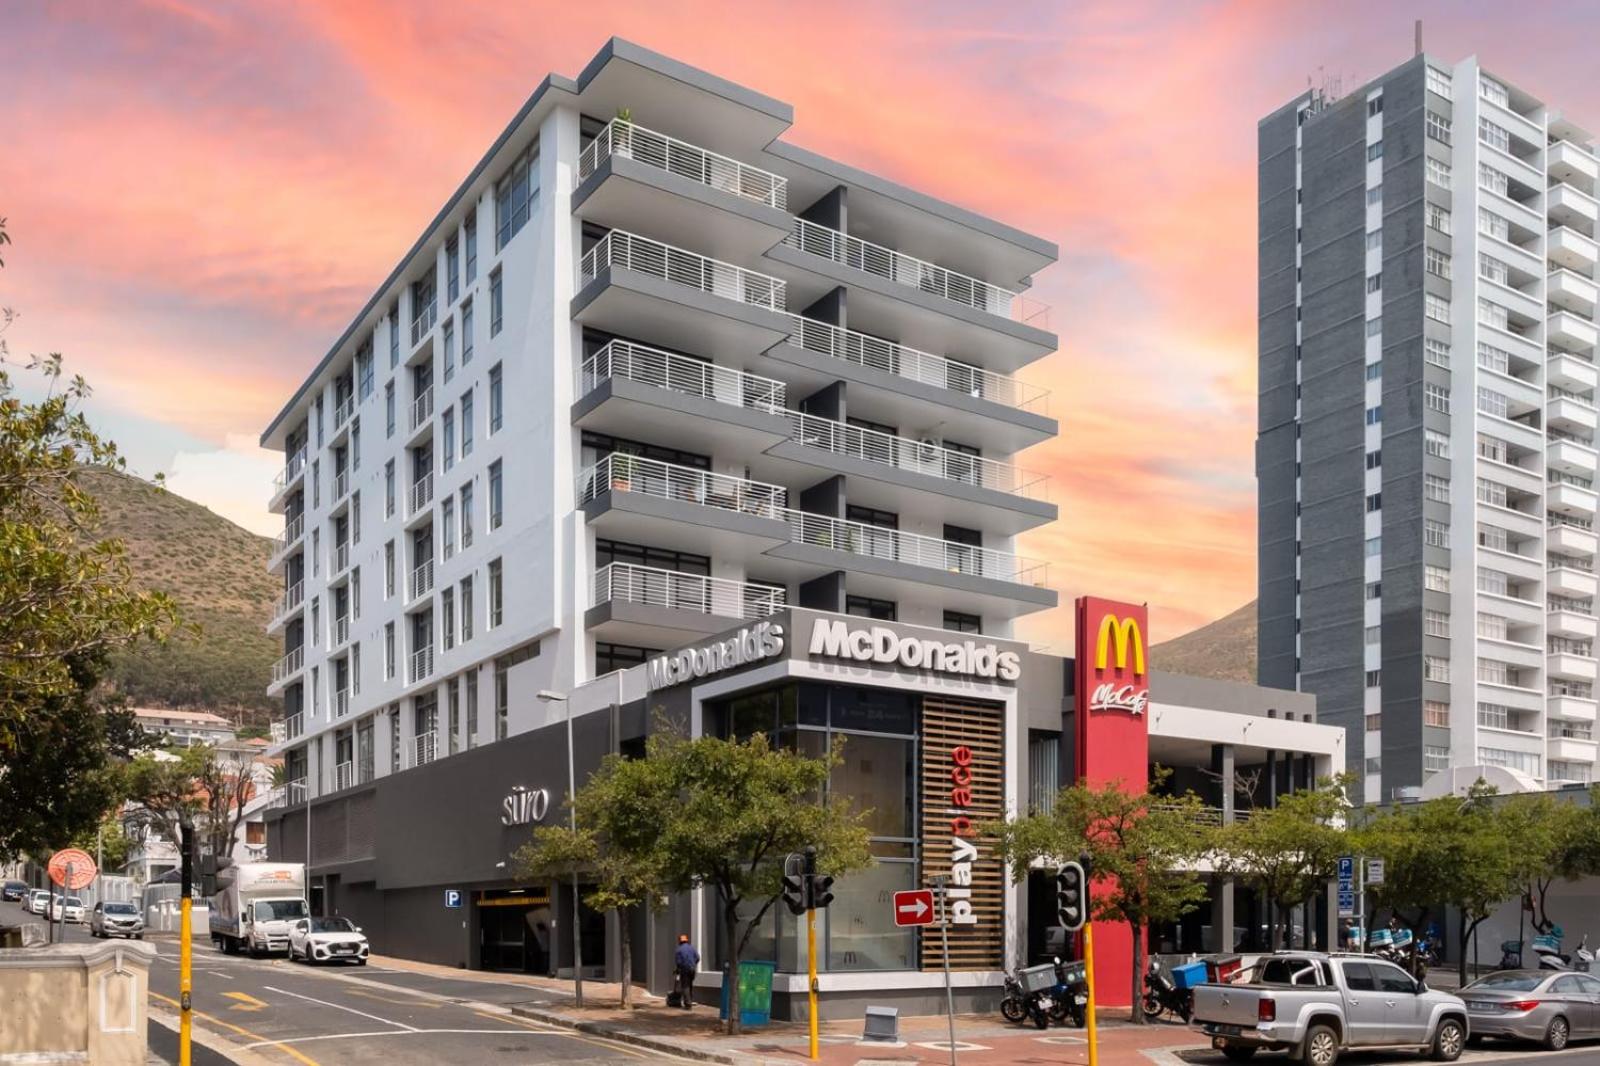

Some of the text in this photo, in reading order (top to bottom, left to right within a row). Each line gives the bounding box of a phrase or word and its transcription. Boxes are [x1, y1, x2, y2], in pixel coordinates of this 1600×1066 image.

[647, 621, 784, 691] McDonald's
[808, 618, 1021, 681] McDonald's
[1341, 860, 1350, 870] P
[448, 891, 460, 906] P
